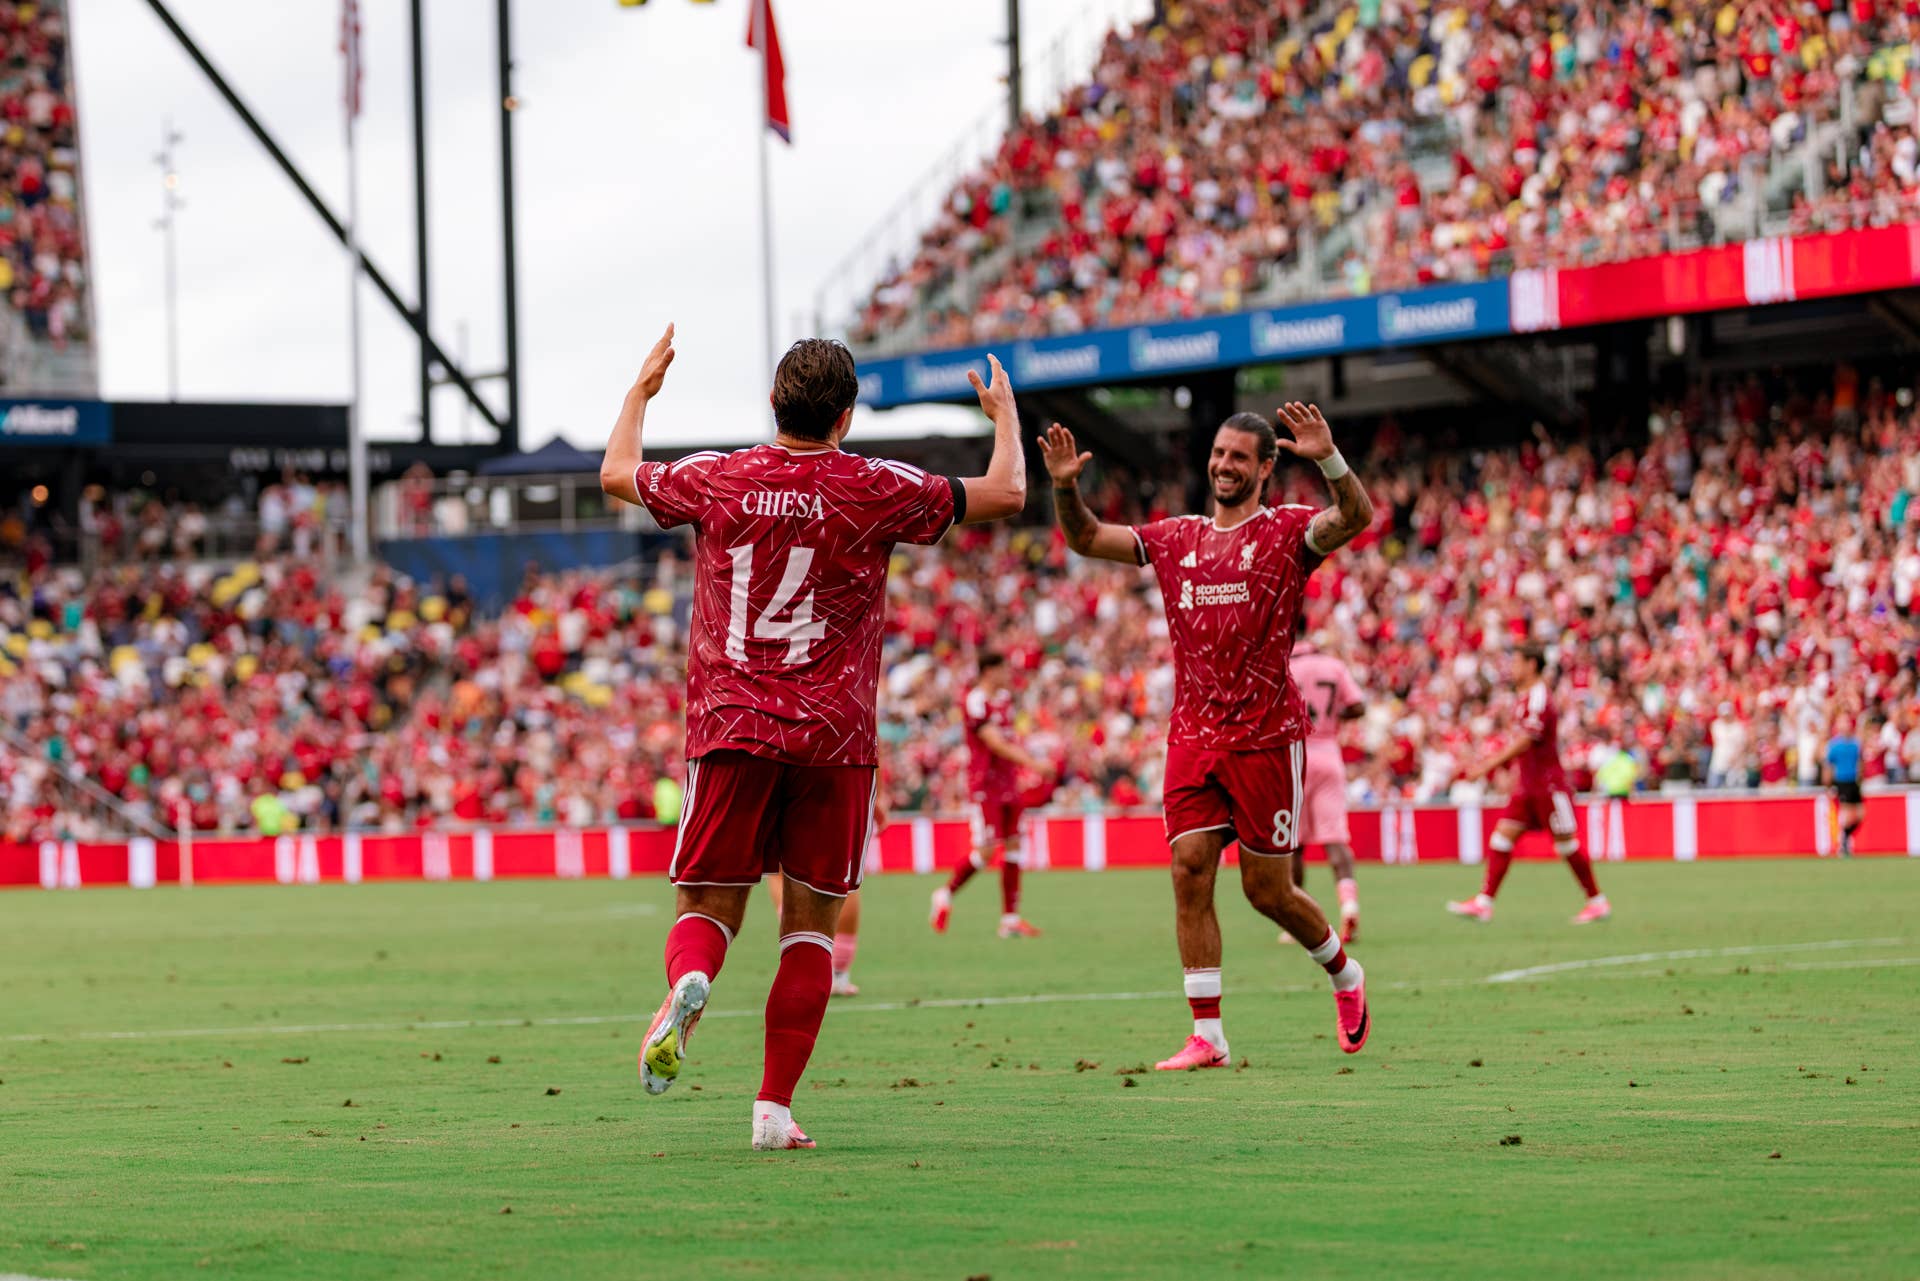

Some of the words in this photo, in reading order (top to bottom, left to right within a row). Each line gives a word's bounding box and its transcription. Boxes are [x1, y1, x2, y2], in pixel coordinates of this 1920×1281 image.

[741, 490, 825, 520] CHIESA
[1195, 581, 1247, 594] standard
[1195, 591, 1249, 606] chartered
[726, 544, 829, 665] 14
[1271, 809, 1292, 847] 8
